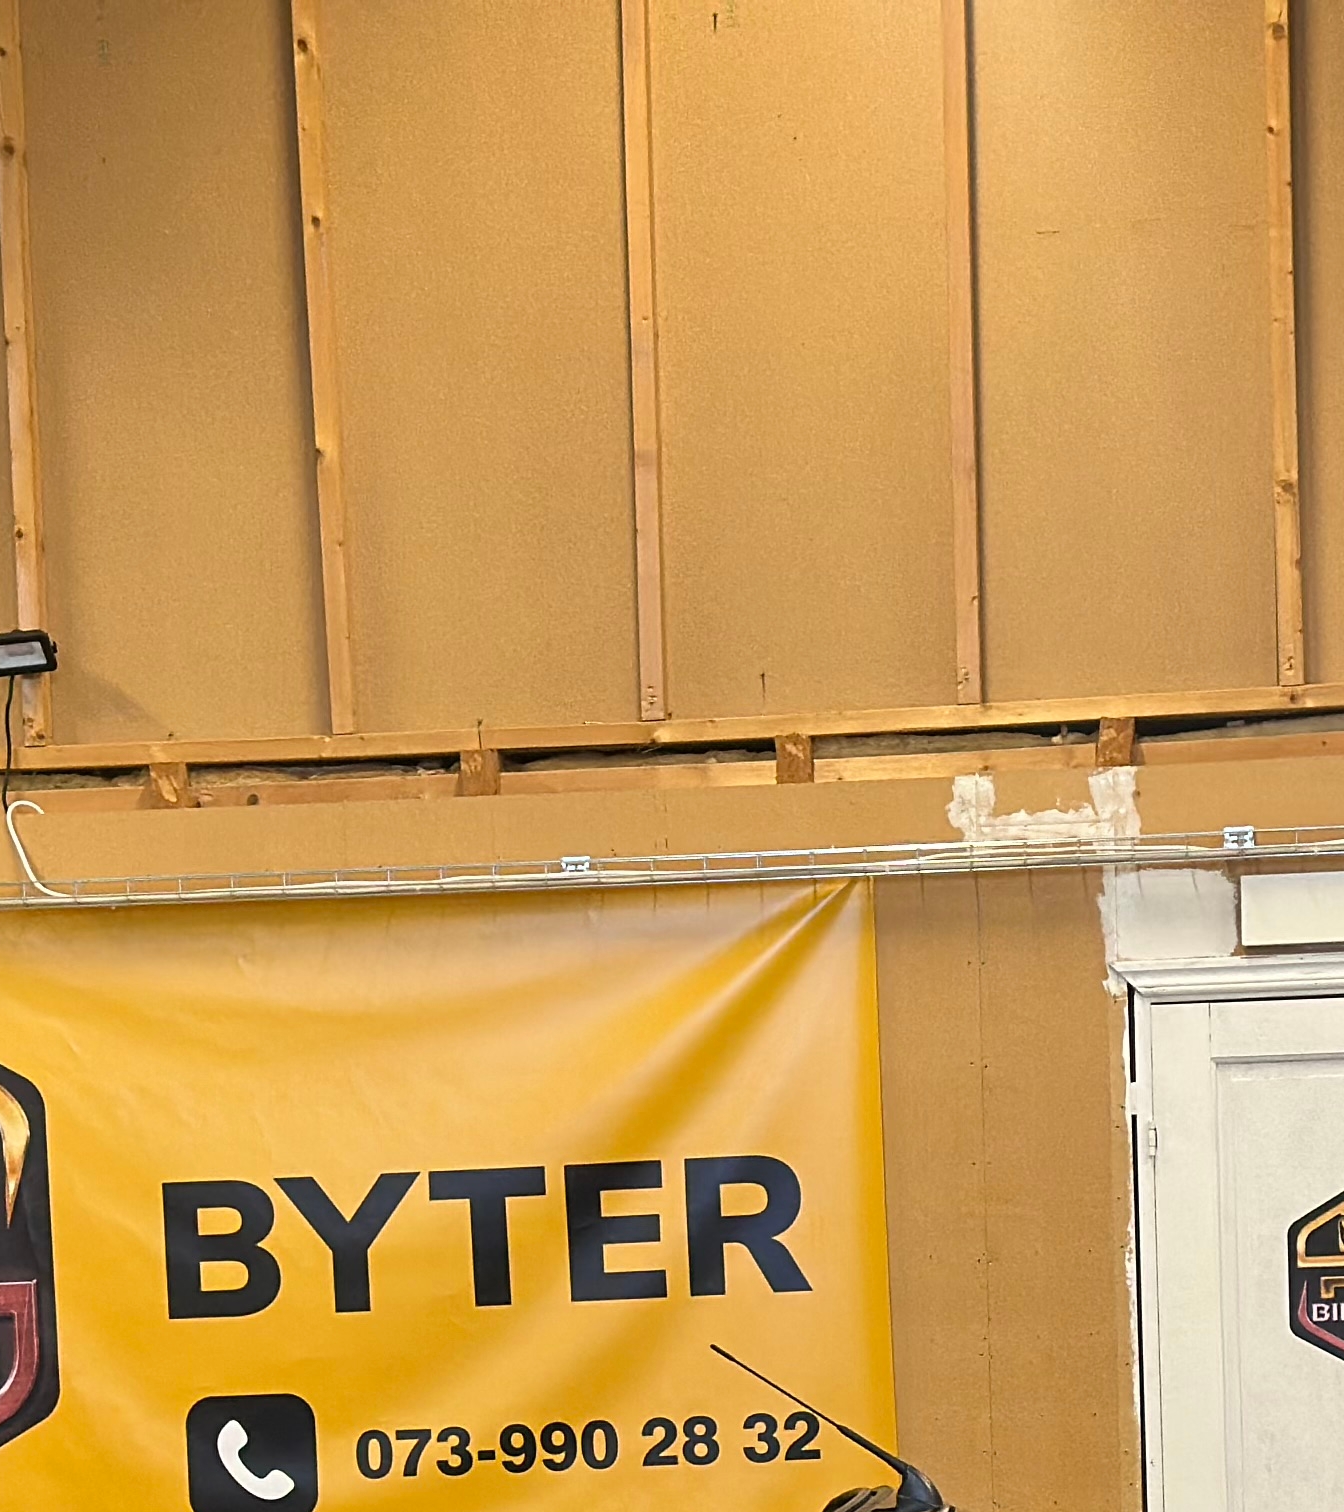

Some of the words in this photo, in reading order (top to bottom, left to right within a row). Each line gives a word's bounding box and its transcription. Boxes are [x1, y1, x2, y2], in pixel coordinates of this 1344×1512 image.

[162, 1155, 813, 1320] BYTER
[355, 1419, 620, 1480] 073-990
[641, 1416, 719, 1467] 28
[742, 1411, 822, 1463] 32
